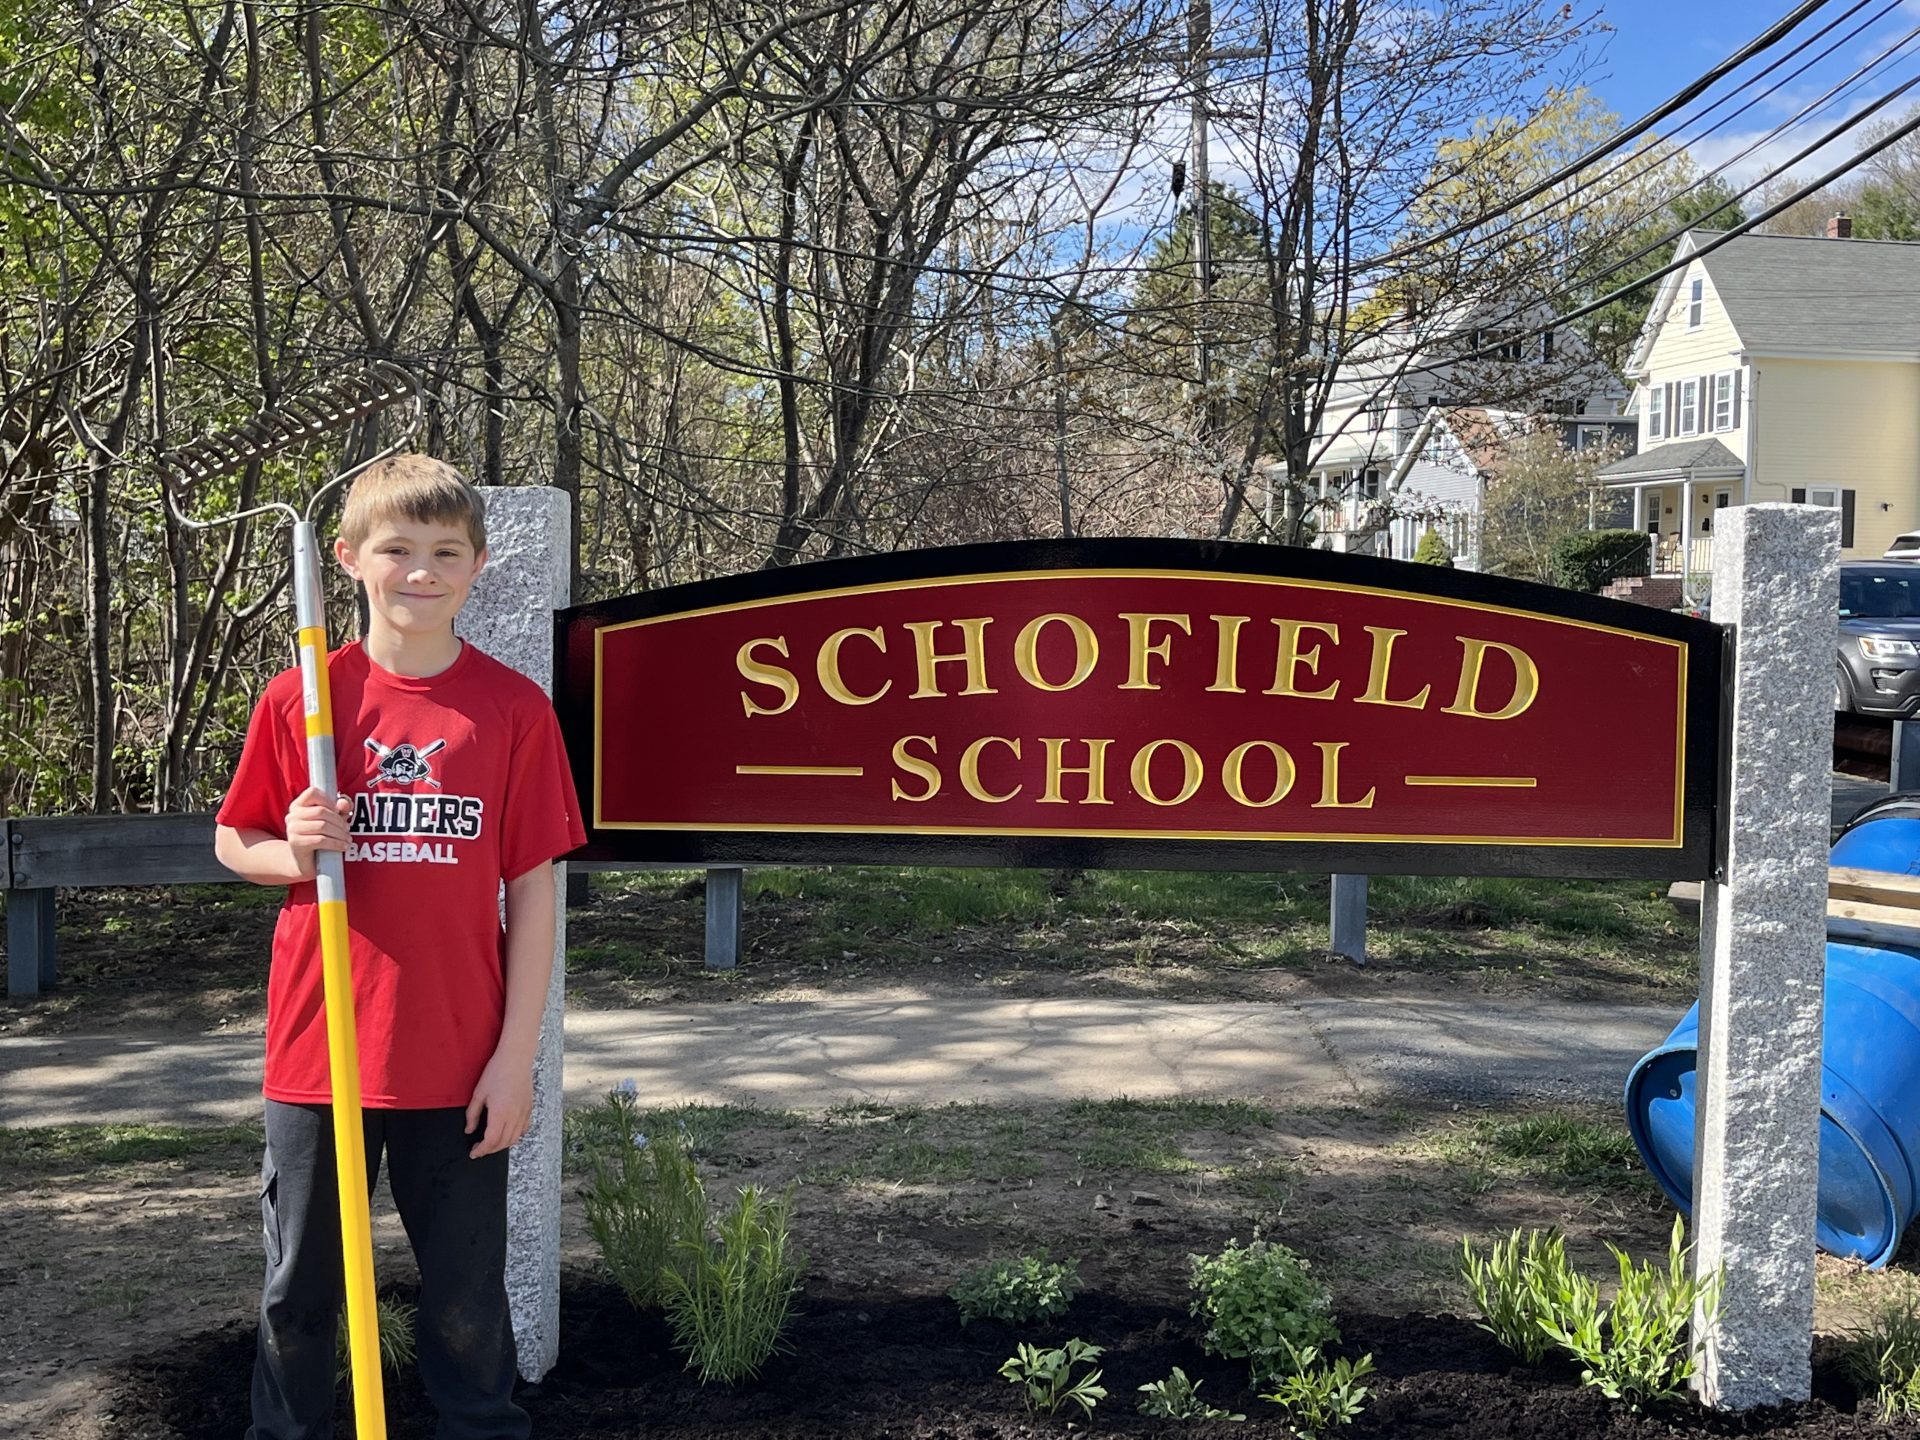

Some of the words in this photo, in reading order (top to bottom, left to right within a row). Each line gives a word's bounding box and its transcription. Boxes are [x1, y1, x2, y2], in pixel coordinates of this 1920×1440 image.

[736, 613, 1540, 719] SCHOFIELD
[891, 735, 1376, 808] SCHOOL
[345, 793, 483, 840] AIDERS
[344, 842, 458, 864] BASEBALL
